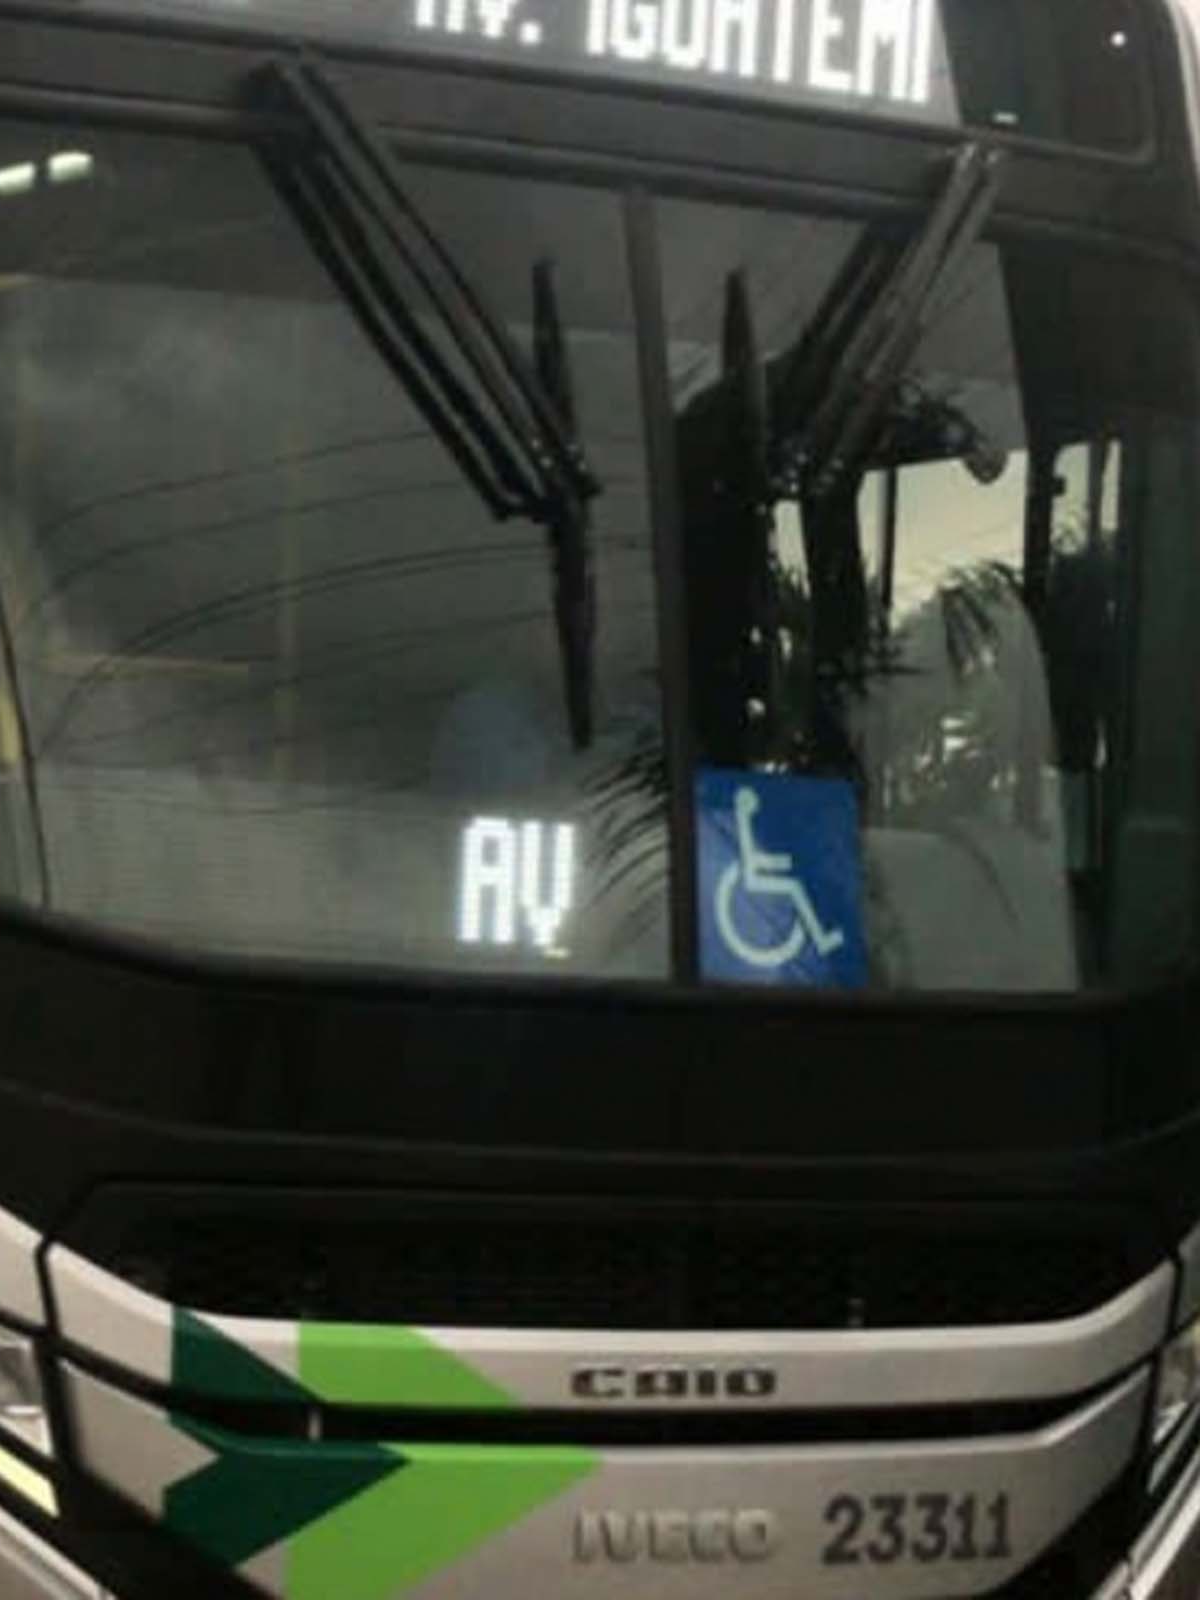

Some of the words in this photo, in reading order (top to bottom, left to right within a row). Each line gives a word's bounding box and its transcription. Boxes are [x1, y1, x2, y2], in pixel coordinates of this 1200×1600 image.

[456, 815, 576, 944] AV
[571, 1367, 778, 1398] CAIO
[572, 1506, 779, 1563] IVECO
[822, 1491, 1012, 1565] 23311
